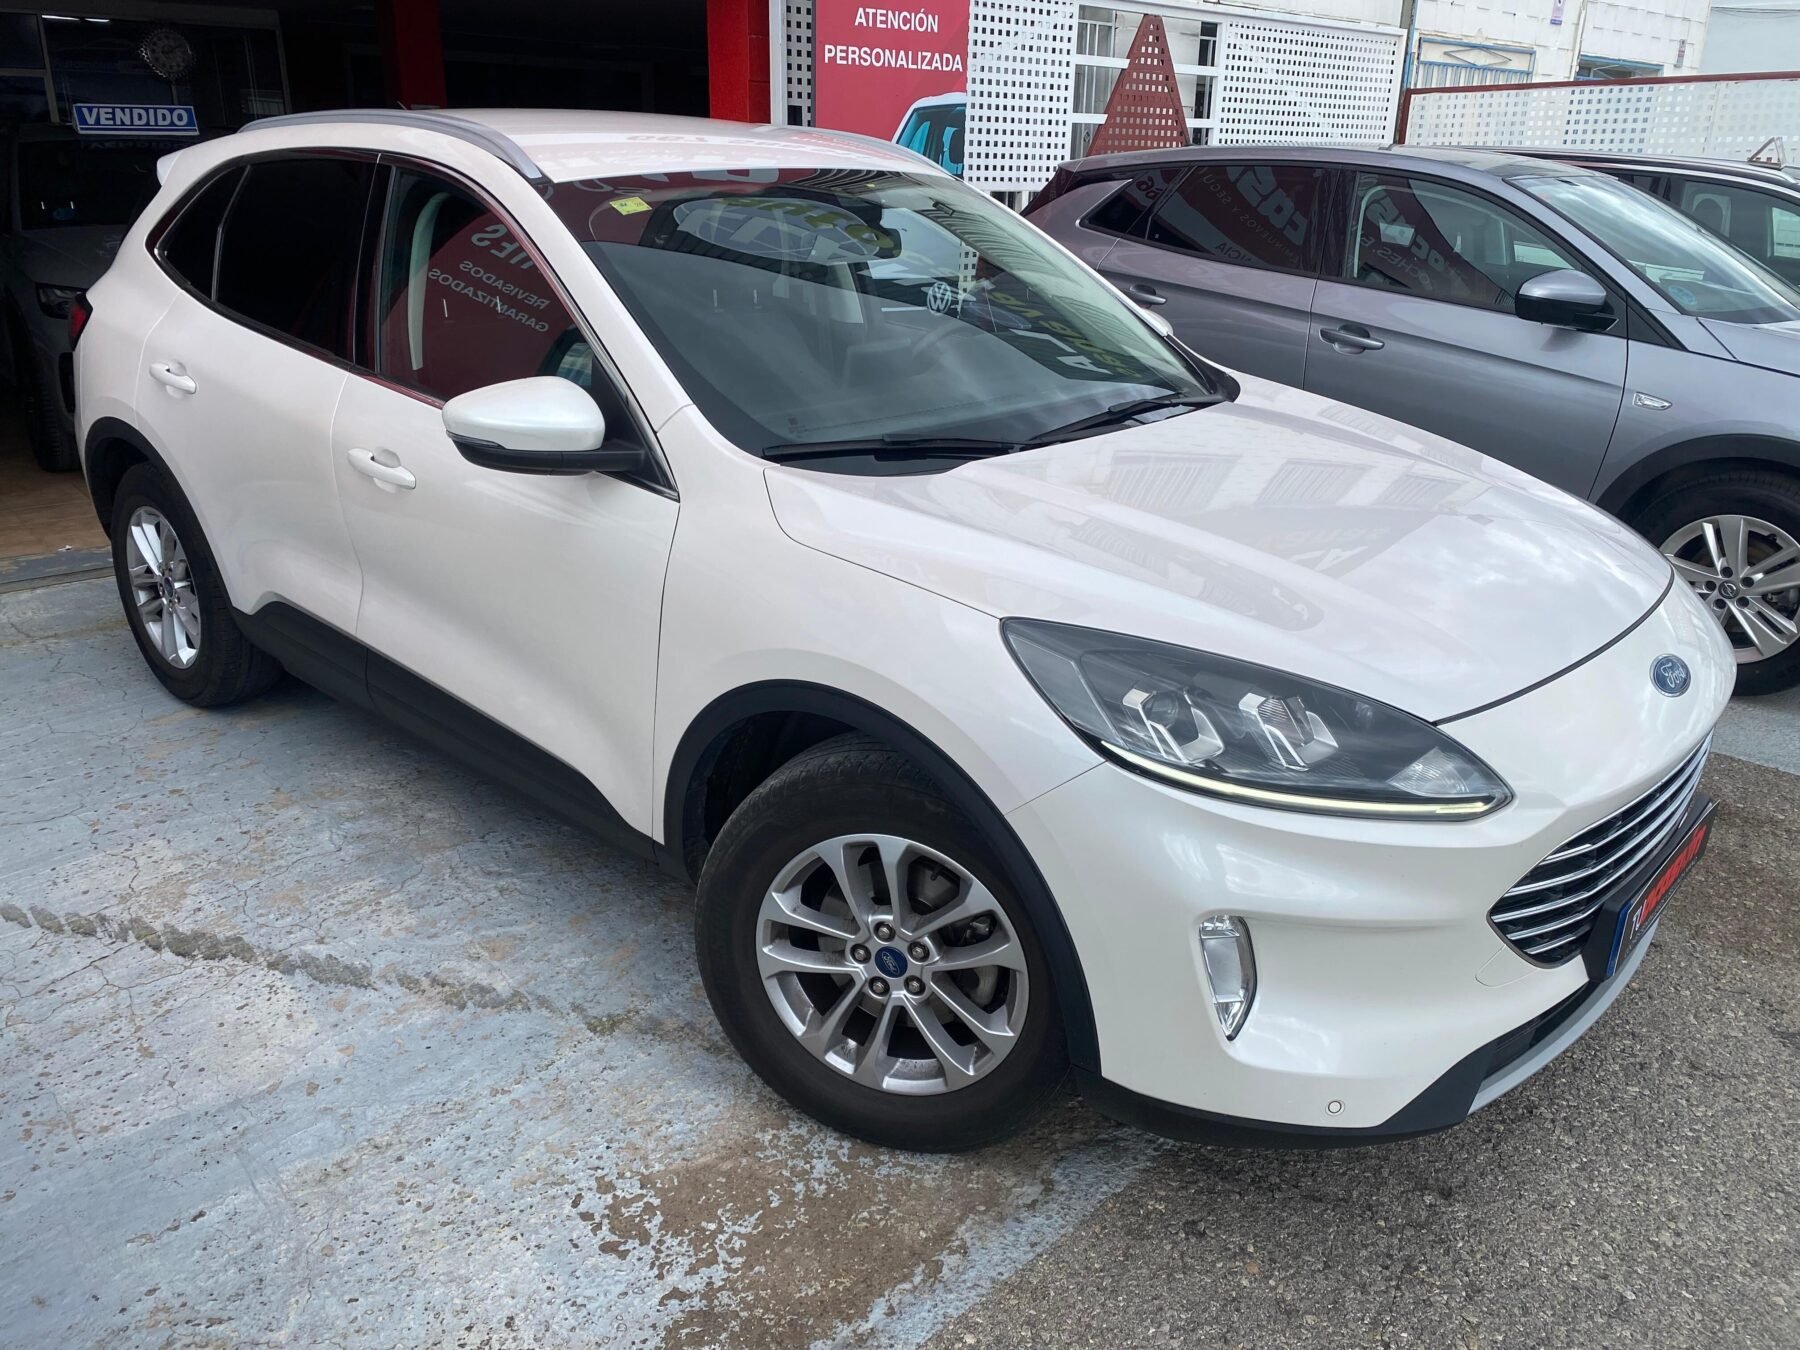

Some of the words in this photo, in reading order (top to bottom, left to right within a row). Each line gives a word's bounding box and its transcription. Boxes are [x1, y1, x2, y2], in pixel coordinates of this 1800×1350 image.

[854, 7, 939, 33] ATENCIÓN
[824, 44, 964, 72] PERSONALIZADA
[81, 107, 189, 126] VENDIDO
